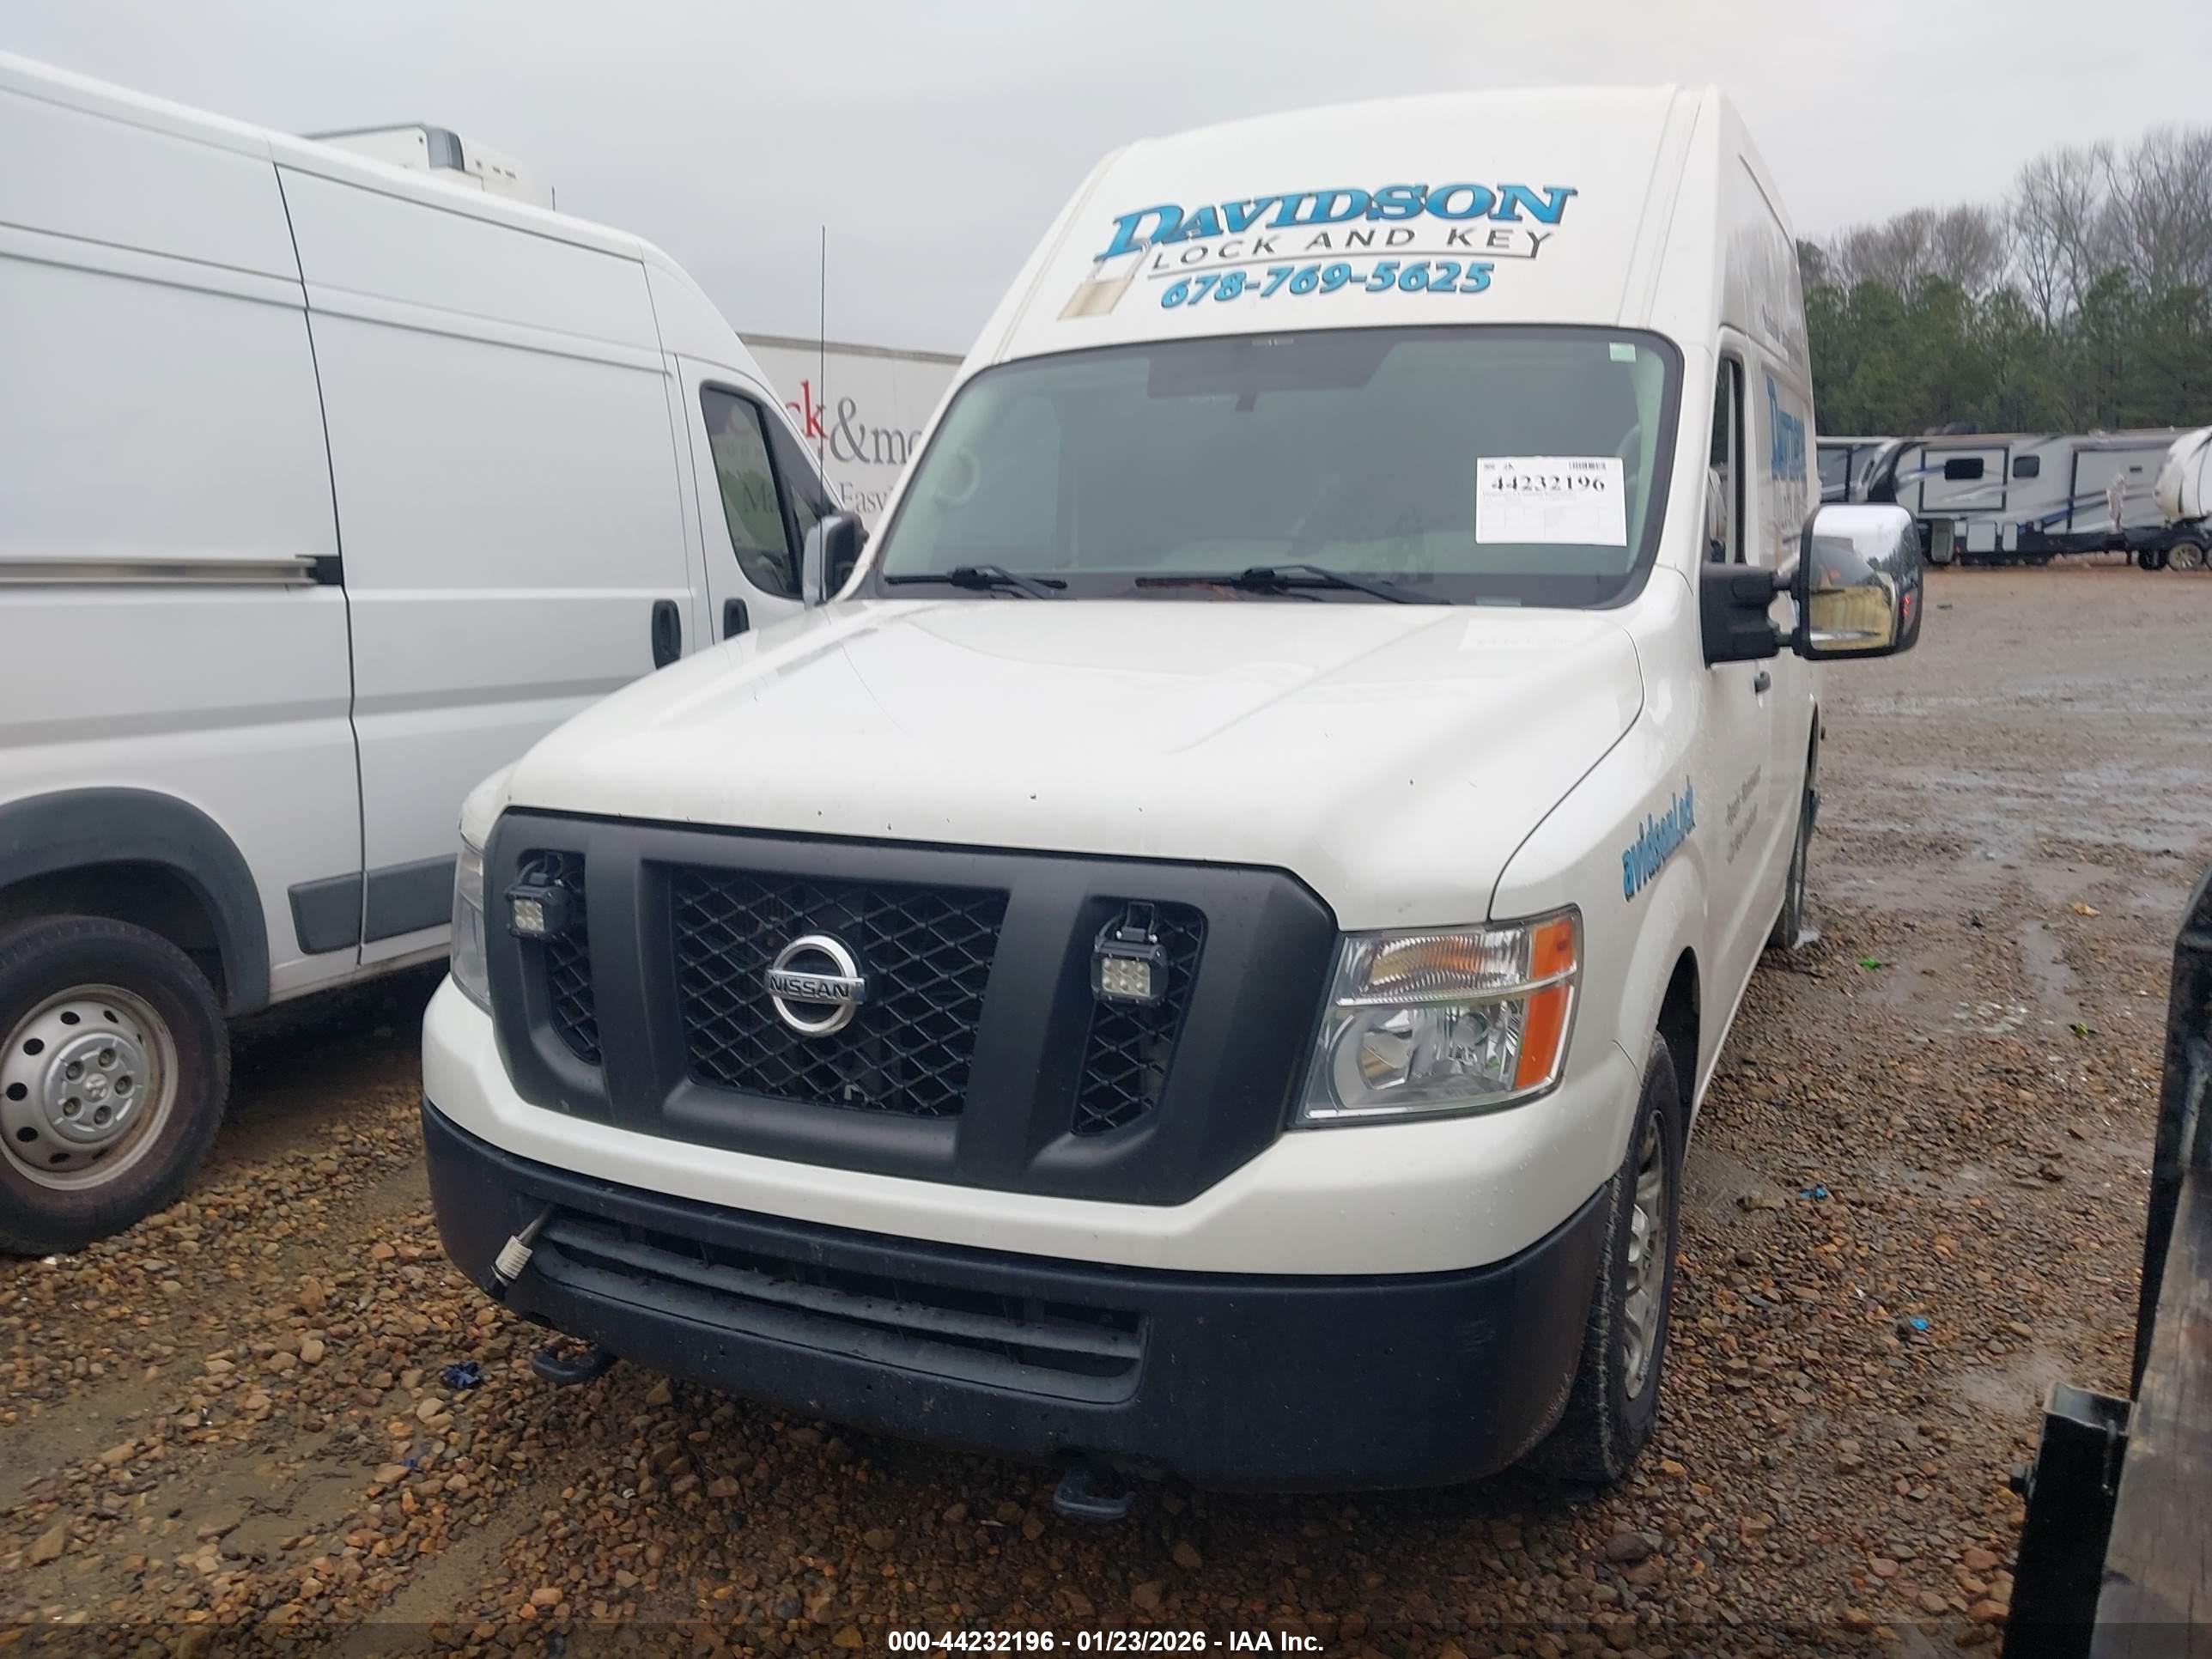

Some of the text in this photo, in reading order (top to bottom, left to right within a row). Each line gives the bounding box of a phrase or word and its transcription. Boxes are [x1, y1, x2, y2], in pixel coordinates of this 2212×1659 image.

[1094, 182, 1578, 263] DAVIDSON
[1152, 227, 1553, 270] LOCK AND KEY
[1159, 260, 1495, 309] 678-769-5625
[1491, 475, 1606, 493] 44232196
[769, 975, 849, 998] NISSAN
